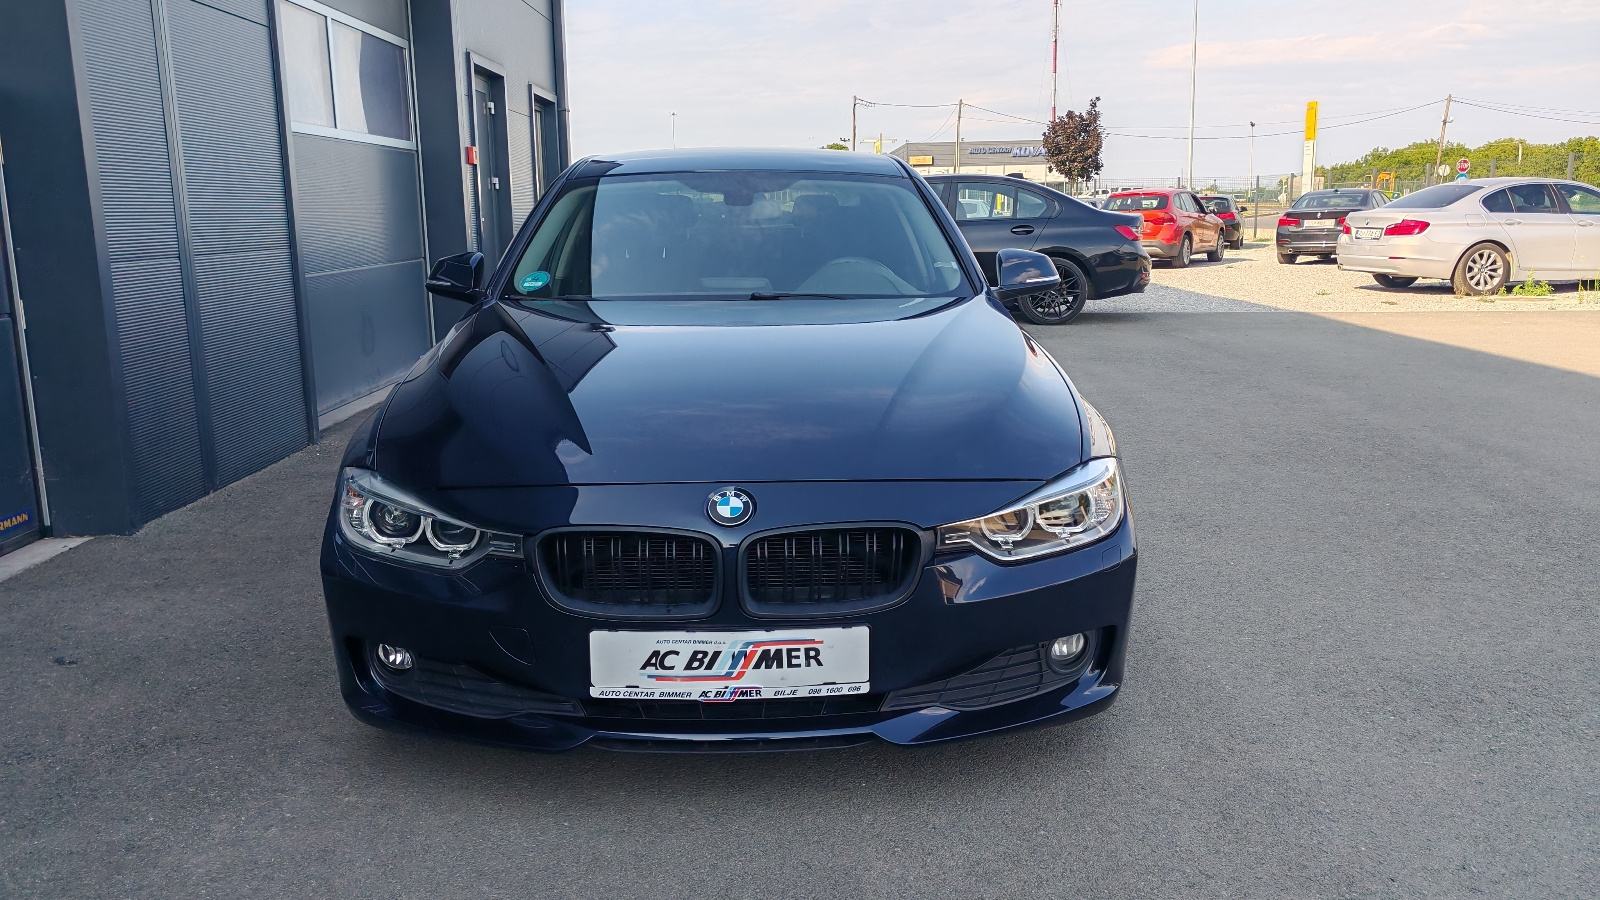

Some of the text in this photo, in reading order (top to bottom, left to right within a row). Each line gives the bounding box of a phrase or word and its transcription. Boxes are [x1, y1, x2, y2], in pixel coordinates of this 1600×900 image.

[712, 490, 749, 502] BMW
[640, 649, 681, 671] AC
[598, 690, 622, 698] AUTO
[622, 690, 656, 698] CENTAR
[658, 691, 693, 699] BIMMER
[699, 690, 712, 698] AC
[773, 688, 799, 697] BILJE
